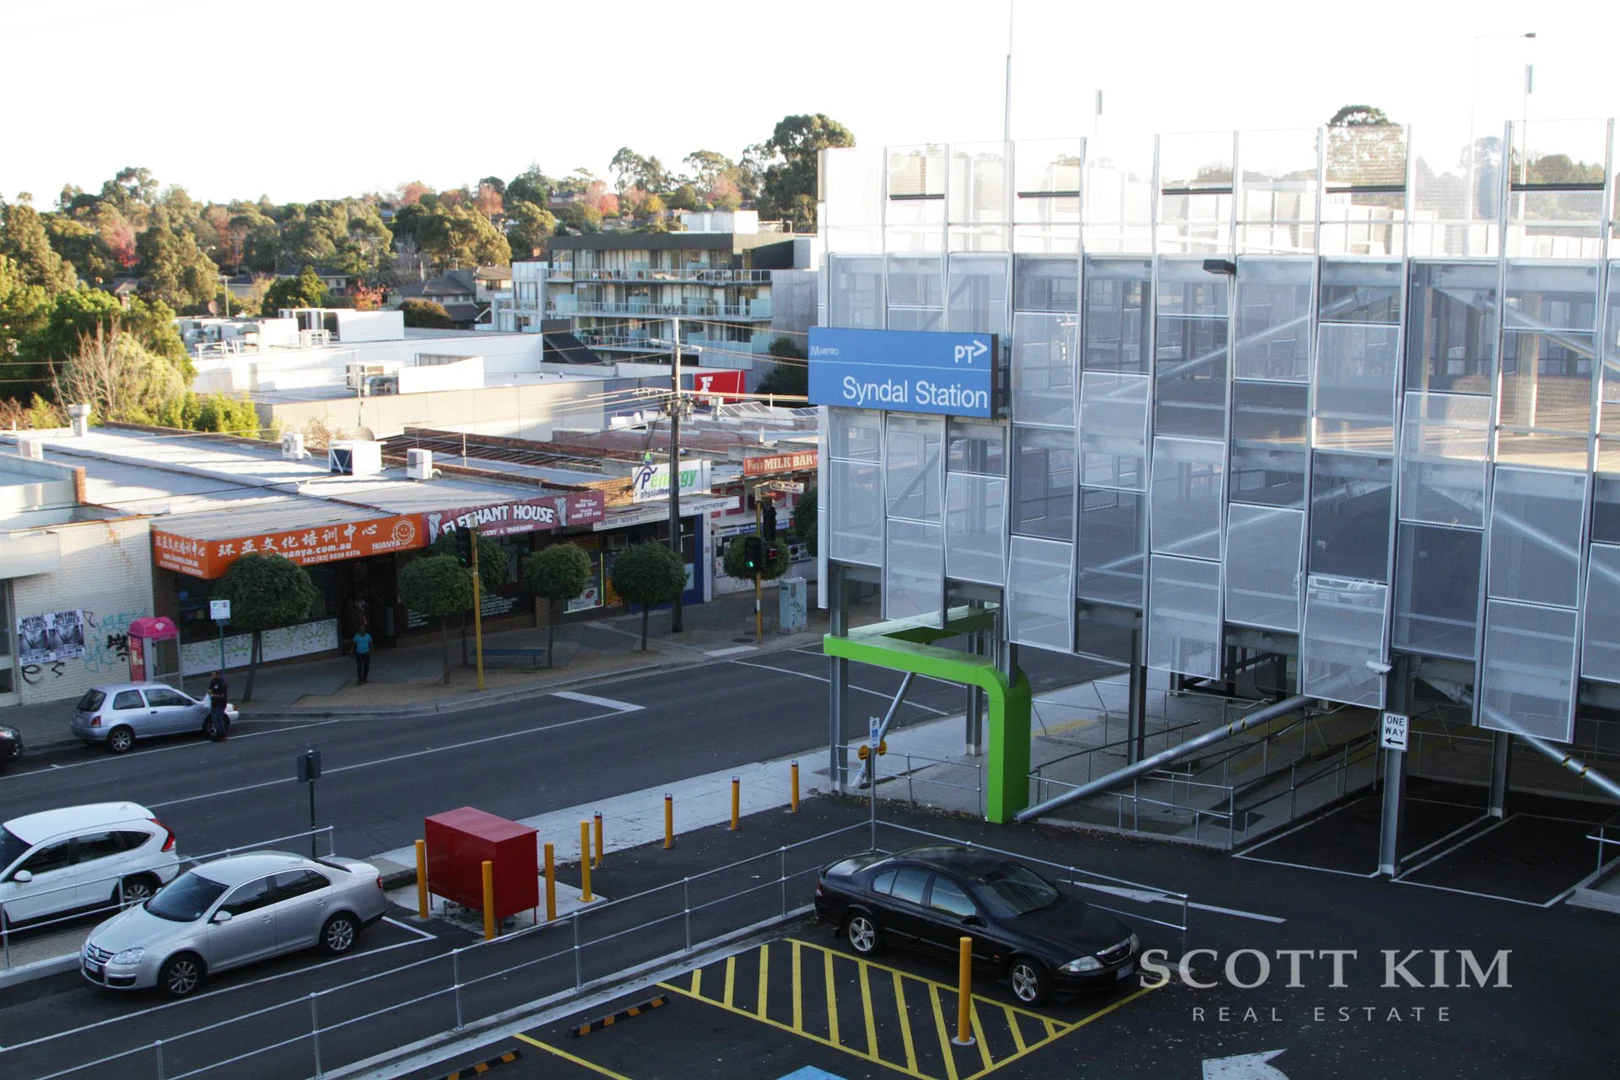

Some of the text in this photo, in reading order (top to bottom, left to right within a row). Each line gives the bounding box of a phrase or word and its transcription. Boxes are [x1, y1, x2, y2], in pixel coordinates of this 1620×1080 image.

[843, 376, 988, 408] Syndal Station
[764, 455, 791, 471] MILK
[793, 453, 813, 467] BAR
[513, 504, 555, 524] HOUSE
[1386, 715, 1405, 727] ONE
[1385, 727, 1405, 737] WAY
